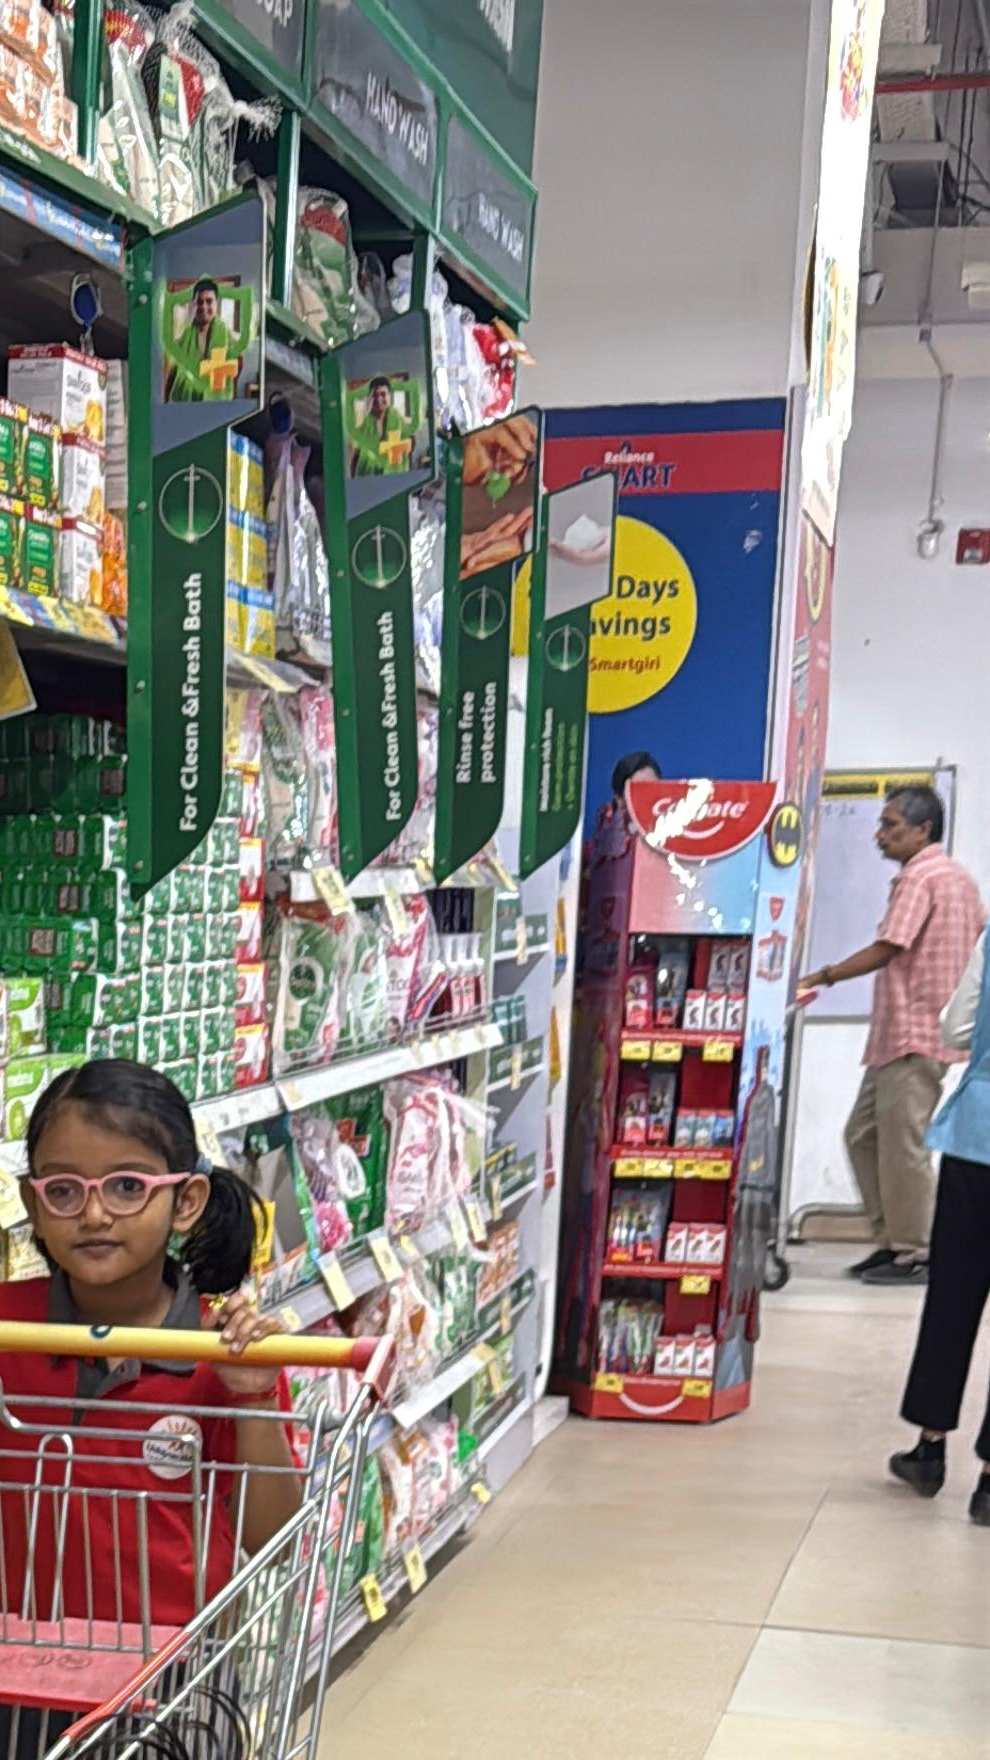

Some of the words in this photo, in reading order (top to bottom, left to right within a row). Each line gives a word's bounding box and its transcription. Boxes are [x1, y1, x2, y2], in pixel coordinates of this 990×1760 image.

[366, 72, 398, 134] HAND
[397, 109, 429, 166] WASH
[183, 572, 204, 630] Bath
[616, 574, 679, 606] Days
[377, 610, 394, 657] Bath
[590, 611, 671, 641] vings
[589, 656, 661, 676] Smartgiri
[458, 691, 474, 731] free
[481, 682, 497, 785] protection
[180, 720, 201, 798] Clean
[384, 729, 401, 789] Clean
[456, 733, 472, 784] Rinse
[179, 801, 198, 832] For
[386, 789, 402, 822] For
